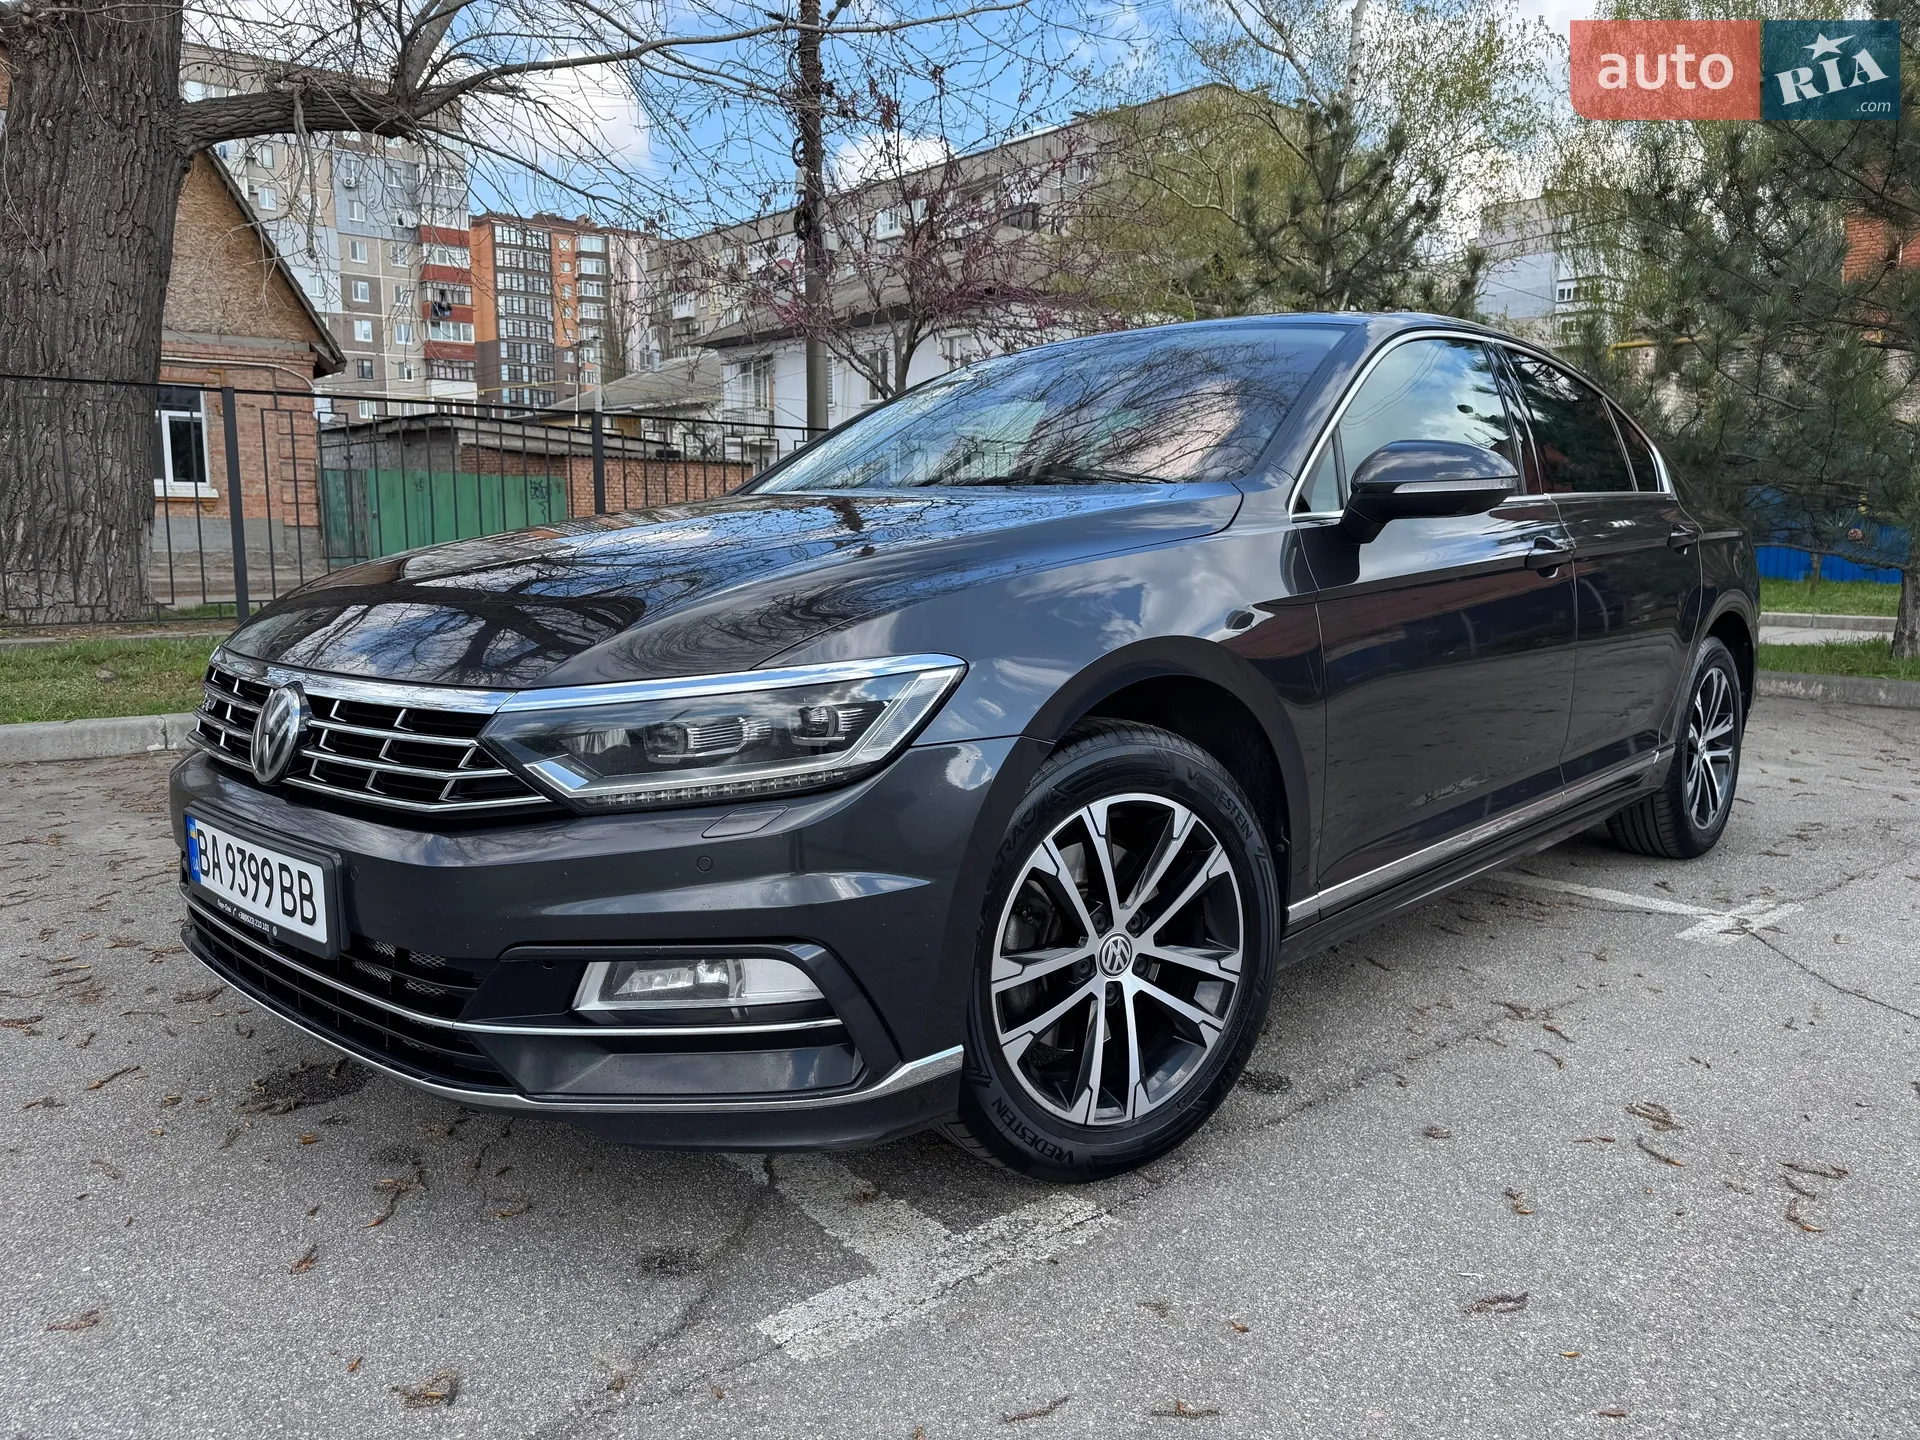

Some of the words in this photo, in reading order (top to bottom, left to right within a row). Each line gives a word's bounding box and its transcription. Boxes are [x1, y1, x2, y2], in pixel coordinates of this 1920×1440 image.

[1187, 766, 1254, 840] VREDESTEIN
[197, 828, 224, 886] BA
[225, 842, 274, 908] 9399
[278, 862, 317, 926] BB
[991, 1096, 1074, 1164] VREDESTEIN
